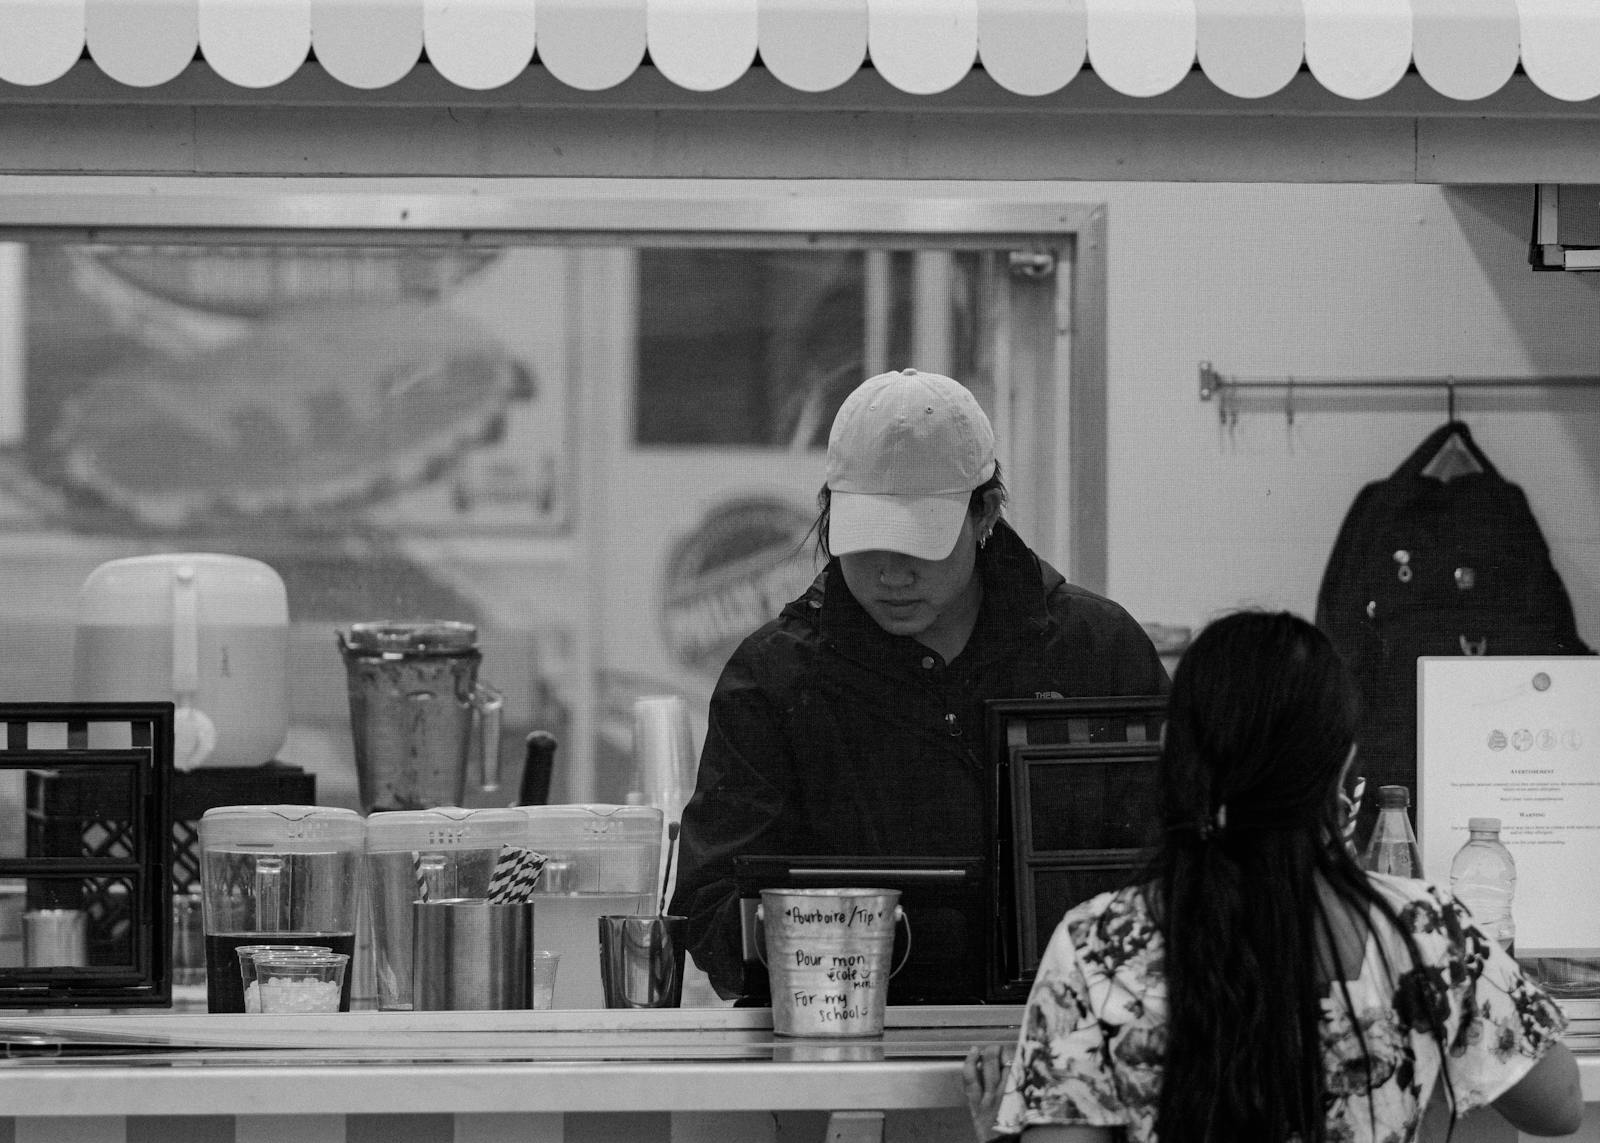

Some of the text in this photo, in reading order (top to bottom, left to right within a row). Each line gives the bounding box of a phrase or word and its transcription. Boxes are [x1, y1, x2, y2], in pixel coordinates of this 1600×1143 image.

[796, 949, 865, 967] Pour mon
[794, 990, 848, 1008] For my
[819, 1005, 859, 1023] school
